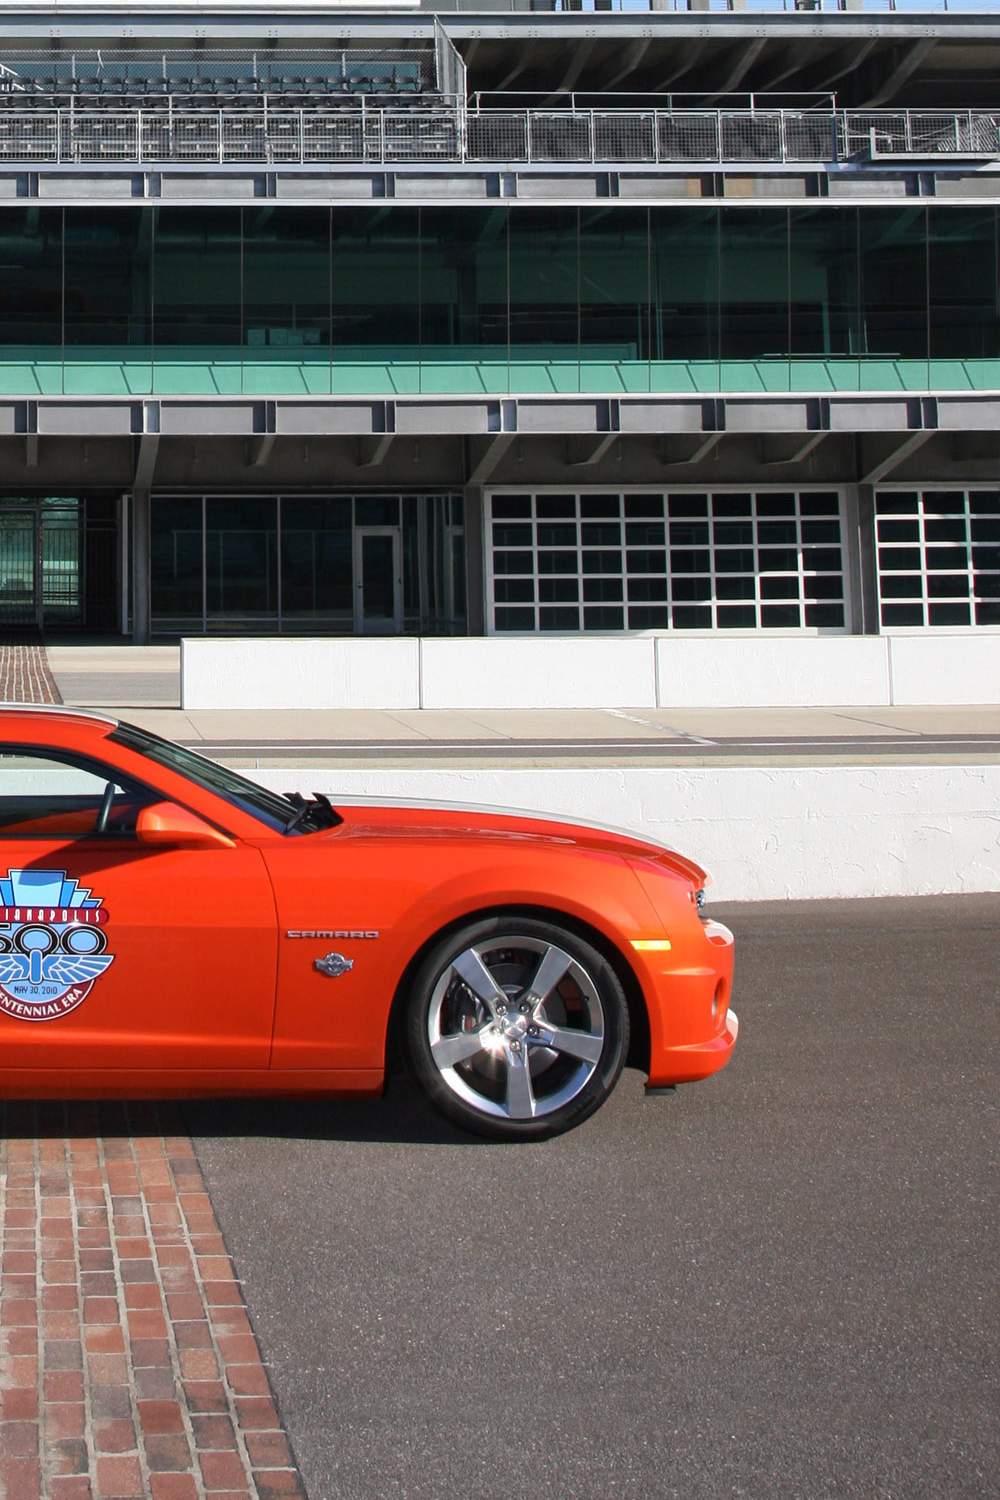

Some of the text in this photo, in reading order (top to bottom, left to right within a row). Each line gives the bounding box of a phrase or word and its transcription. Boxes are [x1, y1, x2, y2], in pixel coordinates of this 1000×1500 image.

[14, 986, 29, 995] MAY
[42, 986, 58, 995] 2010
[63, 988, 83, 1008] ERA
